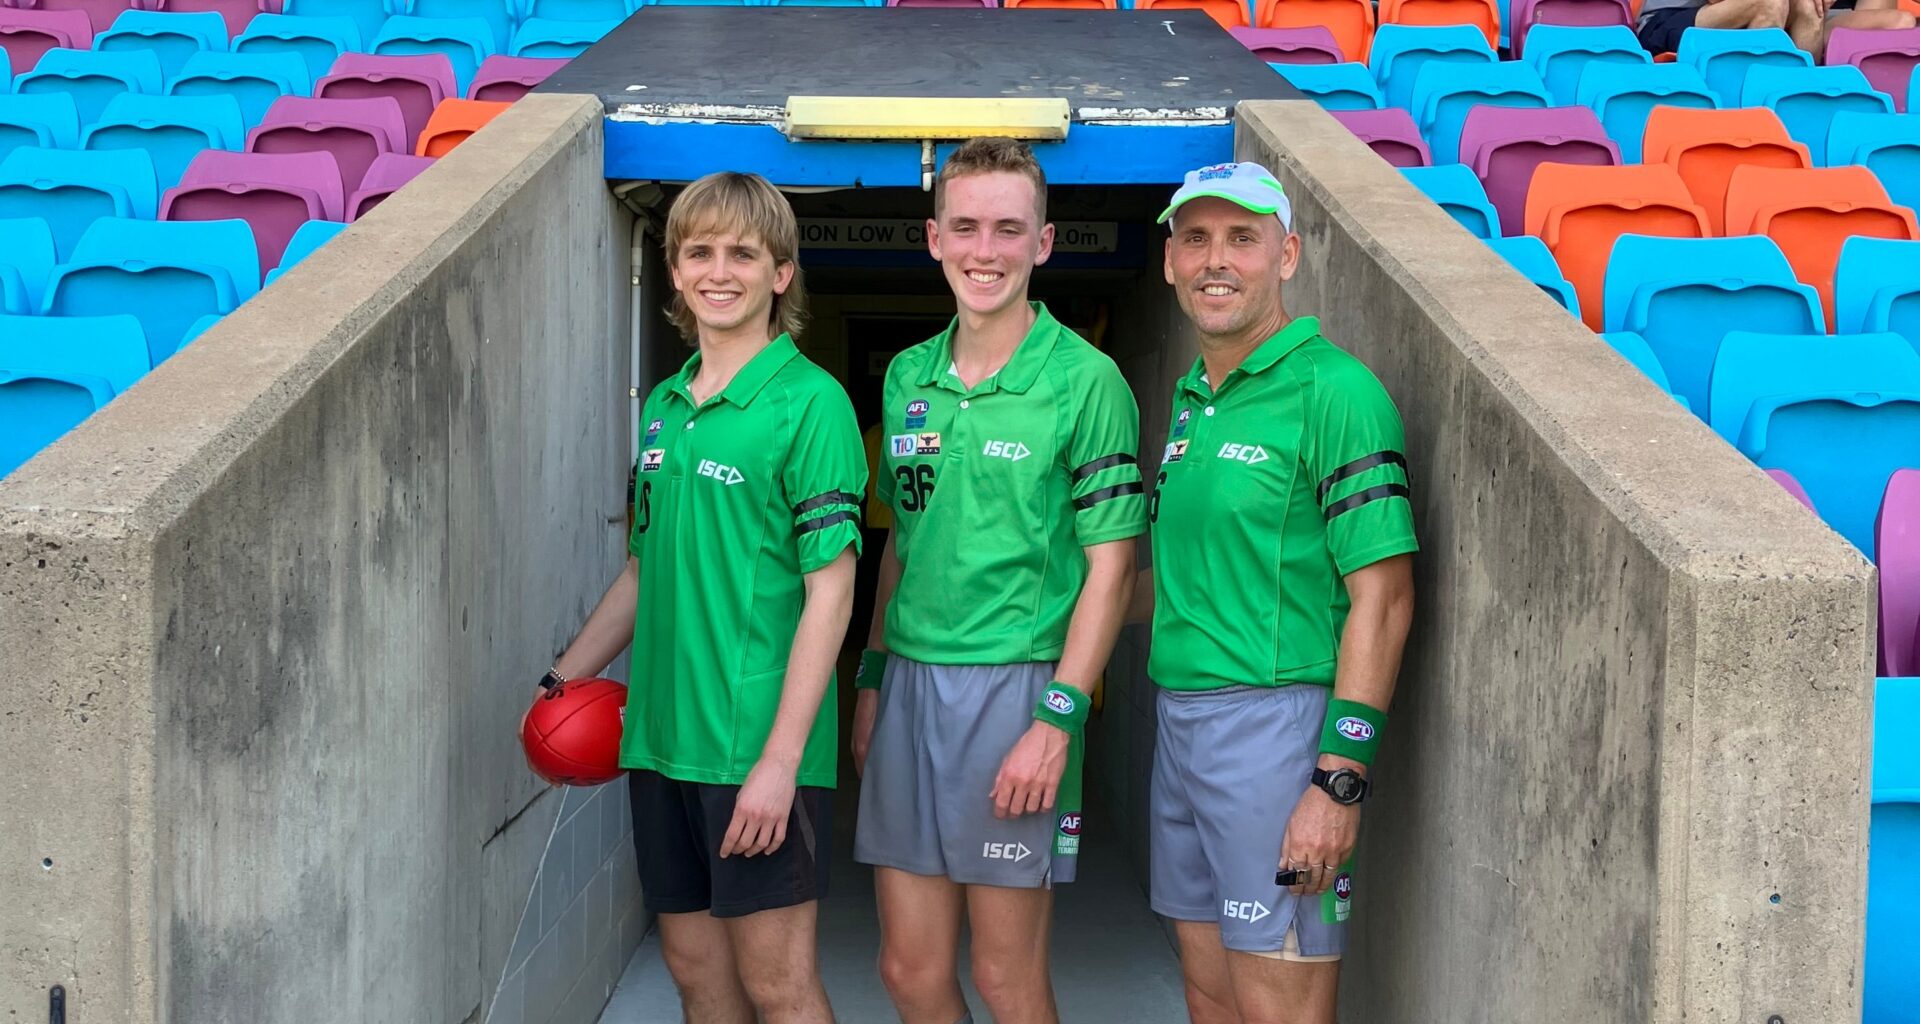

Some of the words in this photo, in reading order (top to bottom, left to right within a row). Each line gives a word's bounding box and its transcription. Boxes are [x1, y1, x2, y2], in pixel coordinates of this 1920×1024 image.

[847, 226, 894, 242] LOW
[895, 438, 914, 453] TIO
[895, 464, 935, 512] 36
[1047, 692, 1071, 710] AFL
[1339, 721, 1370, 738] AFL
[1060, 816, 1082, 829] AF
